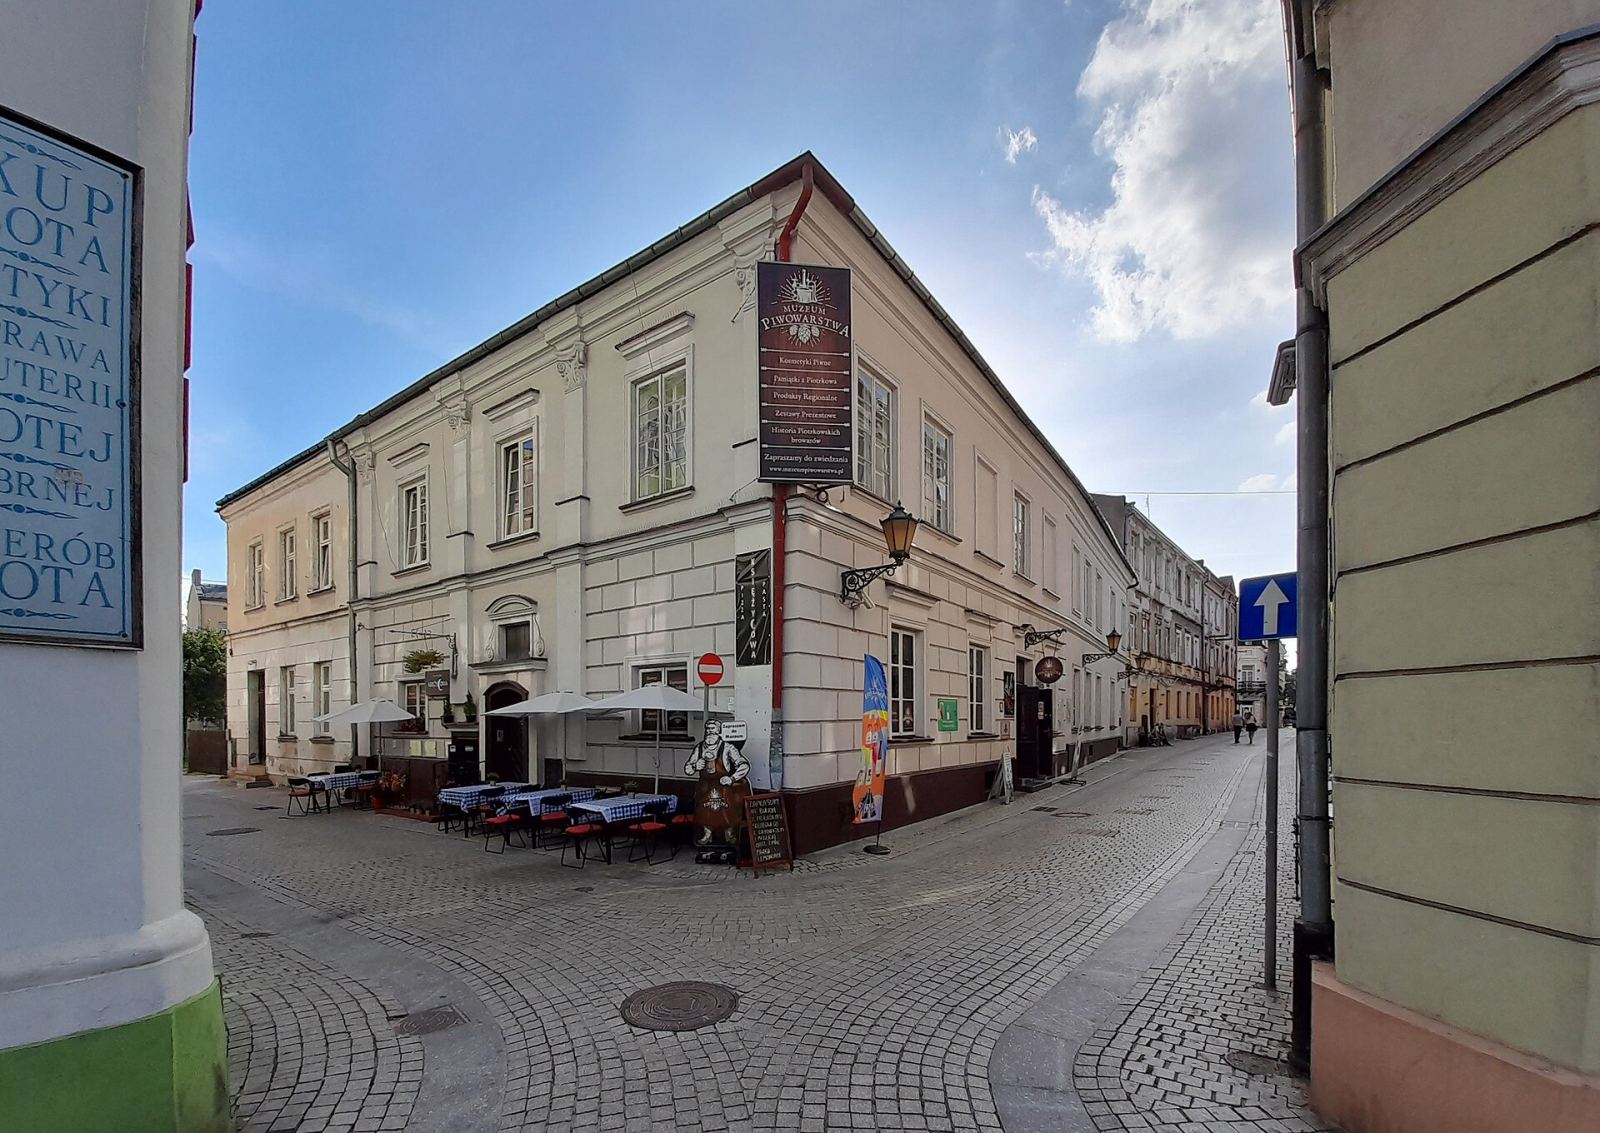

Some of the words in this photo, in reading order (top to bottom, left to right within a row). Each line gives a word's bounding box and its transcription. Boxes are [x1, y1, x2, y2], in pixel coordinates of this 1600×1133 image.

[2, 263, 112, 328] TYKI
[783, 304, 827, 315] MUZEUM
[760, 314, 850, 338] PIWOWARSTWA
[779, 357, 812, 367] Kosmetyki
[813, 359, 832, 367] Piwne
[773, 391, 801, 401] Produkty
[803, 393, 838, 403] Regionalne
[771, 426, 797, 434] Historia
[764, 453, 802, 463] Zapraszamy
[803, 454, 813, 462] do
[4, 529, 116, 570] ERÓB
[0, 561, 115, 609] OTA
